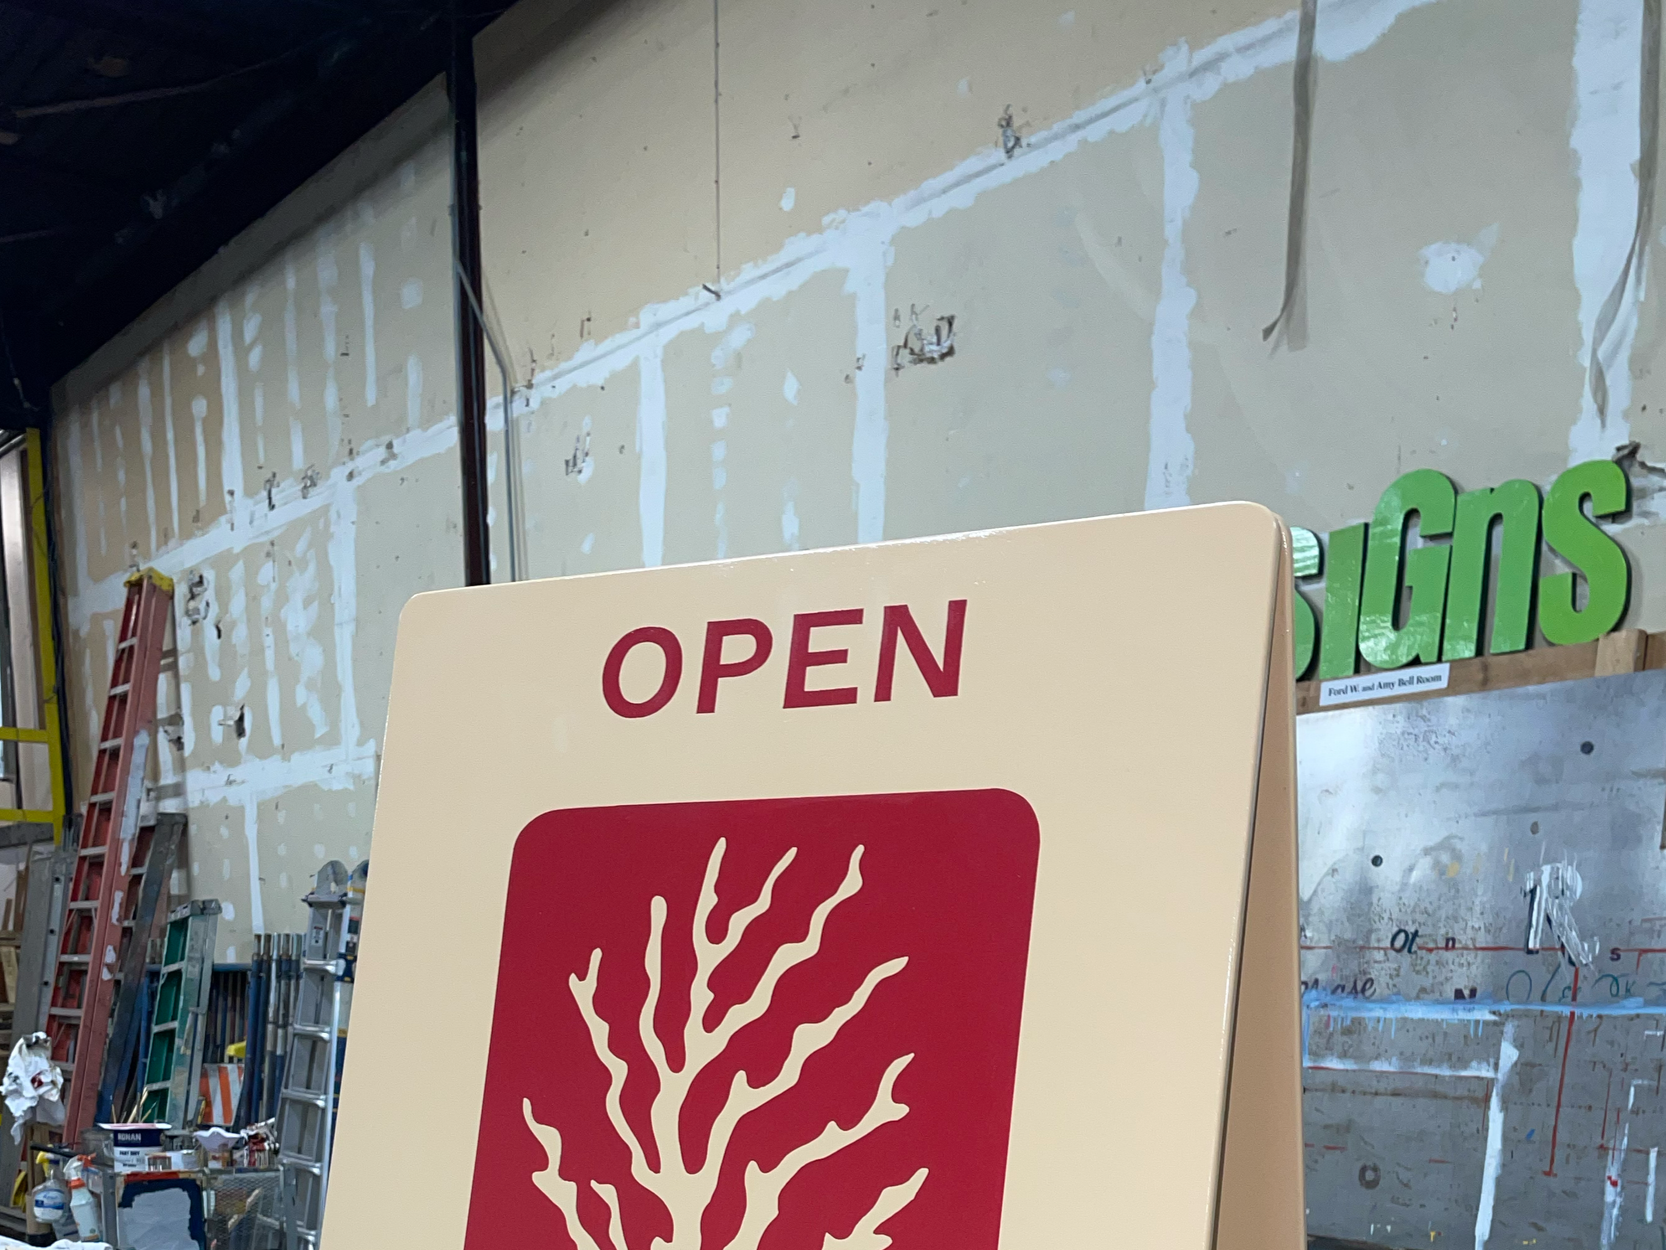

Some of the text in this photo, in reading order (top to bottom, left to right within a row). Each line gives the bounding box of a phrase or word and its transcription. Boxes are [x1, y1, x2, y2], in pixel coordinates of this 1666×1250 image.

[602, 599, 967, 718] OPEN
[1328, 685, 1349, 697] Ford
[1361, 682, 1375, 692] and
[1376, 679, 1396, 691] Amy
[1398, 675, 1415, 687] Bell
[1416, 674, 1442, 685] Room
